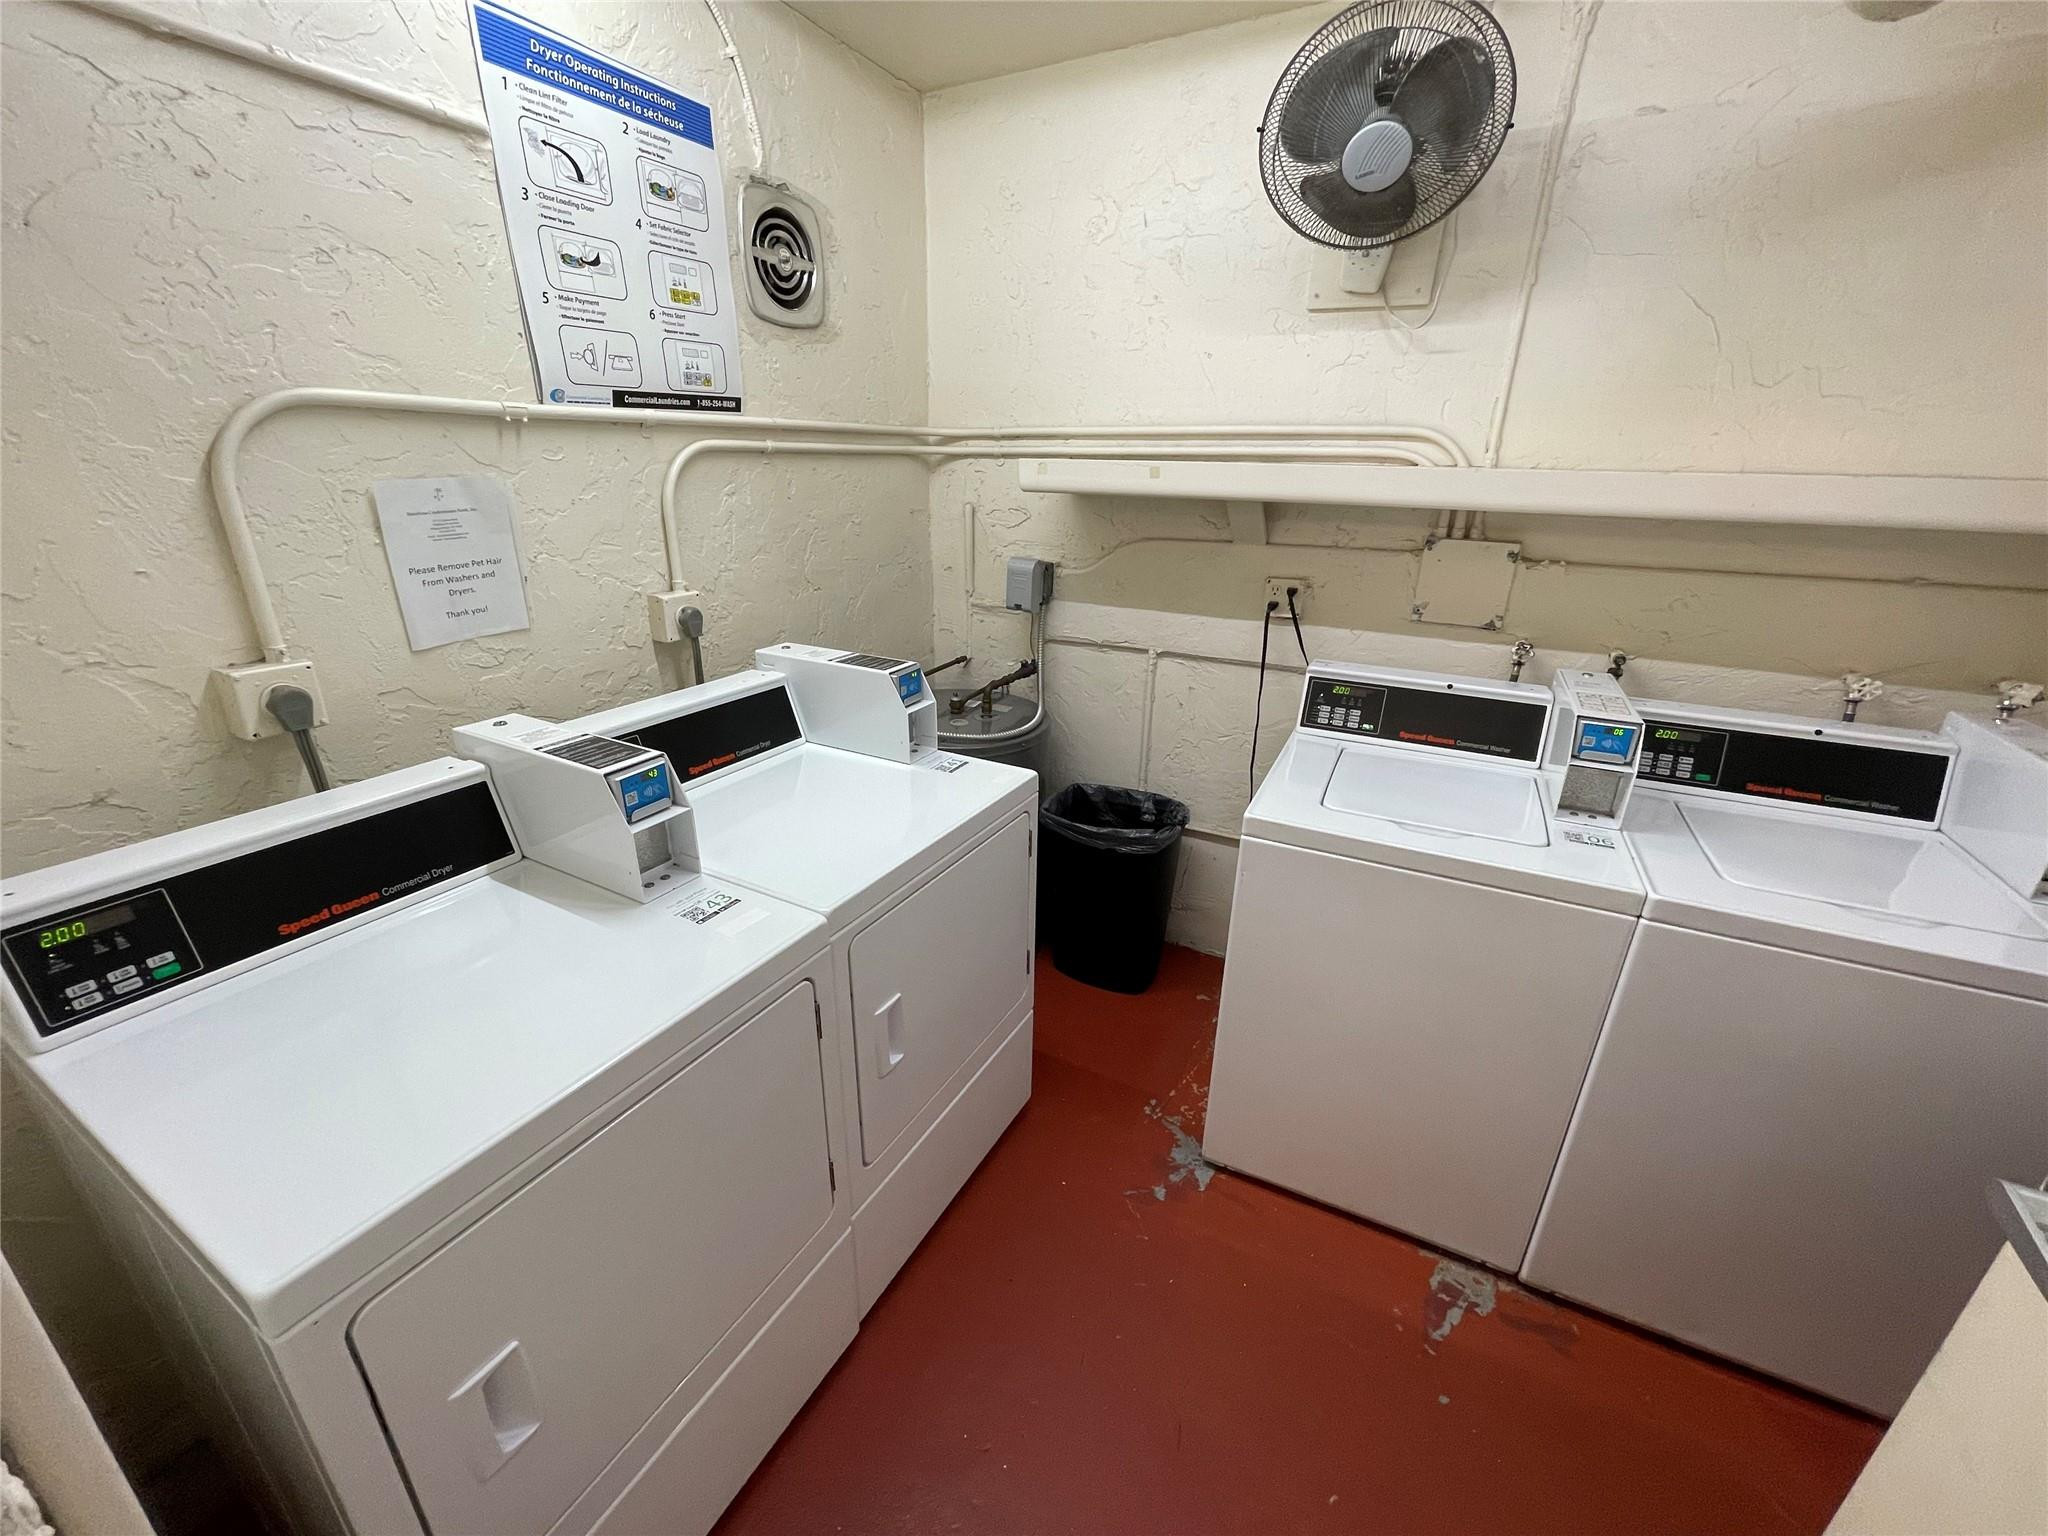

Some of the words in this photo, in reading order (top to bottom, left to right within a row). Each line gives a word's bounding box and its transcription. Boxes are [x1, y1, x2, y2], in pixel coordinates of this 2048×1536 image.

[530, 38, 563, 63] Dryer
[565, 54, 619, 89] Operating
[620, 77, 677, 111] Instructions
[501, 76, 508, 91] 1
[518, 82, 538, 96] Clean
[538, 90, 551, 100] Lint
[552, 95, 568, 106] Filter
[526, 58, 621, 105] Fonctionnement
[618, 96, 631, 112] de
[632, 100, 642, 116] la
[643, 107, 685, 132] sécheuse
[622, 121, 629, 135] 2
[636, 127, 650, 137] Load
[521, 187, 529, 201] 3
[538, 191, 555, 201] Close
[556, 195, 580, 210] Loading
[580, 203, 595, 213] Door
[635, 218, 642, 230] 4
[542, 291, 549, 304] 5
[558, 294, 574, 303] Make
[575, 296, 600, 306] Payment
[650, 309, 656, 320] 6
[662, 310, 674, 318] Press
[674, 312, 686, 320] Start
[624, 394, 691, 406] CommercialLaundries.com
[409, 566, 436, 576] Please
[437, 562, 470, 572] Remove
[471, 558, 485, 568] Pet
[486, 557, 502, 566] Hair
[422, 578, 444, 588] From
[445, 573, 480, 585] Washers
[481, 570, 496, 579] and
[448, 587, 477, 597] Dryers.
[446, 607, 470, 619] Thank
[471, 605, 489, 616] you!
[1613, 728, 1624, 736] 06
[648, 768, 658, 777] 43
[277, 908, 331, 936] Speed
[331, 891, 381, 916] Queen
[381, 872, 431, 897] Commercial
[431, 864, 454, 879] Dryer
[707, 894, 732, 909] 43
[39, 921, 86, 949] 2.00
